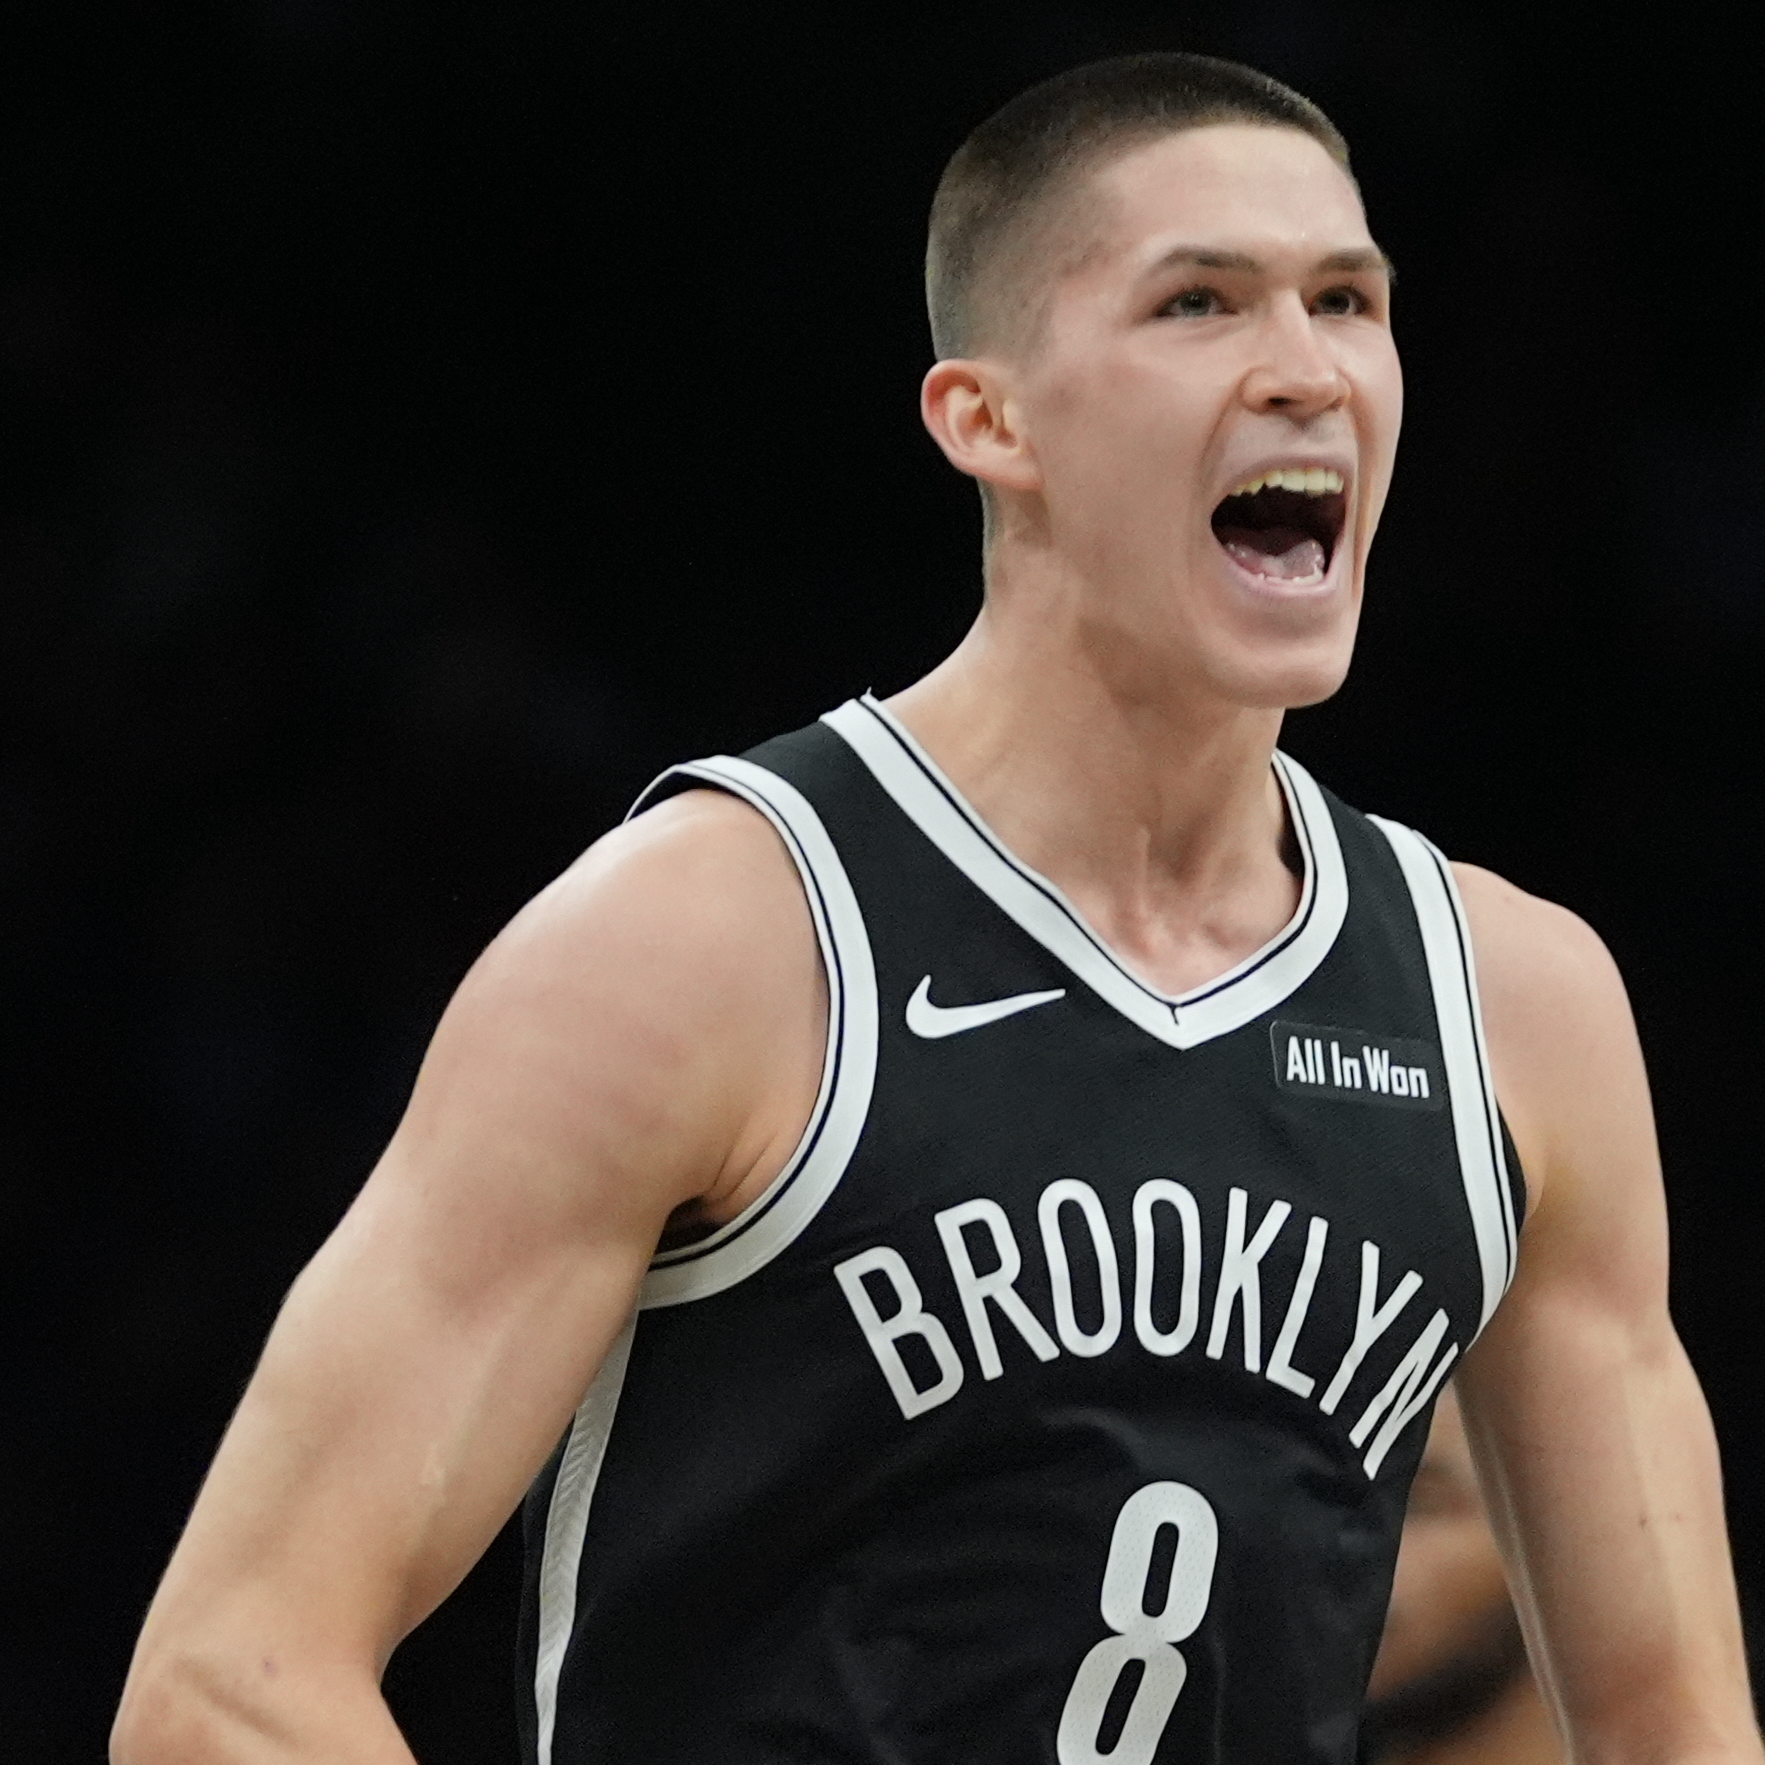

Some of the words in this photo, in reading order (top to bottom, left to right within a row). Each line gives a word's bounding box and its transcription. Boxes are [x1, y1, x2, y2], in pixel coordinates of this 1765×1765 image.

[1286, 1034, 1327, 1086] All
[1330, 1040, 1363, 1090] In
[1361, 1045, 1431, 1100] Won
[834, 1178, 1459, 1481] BROOKLYN
